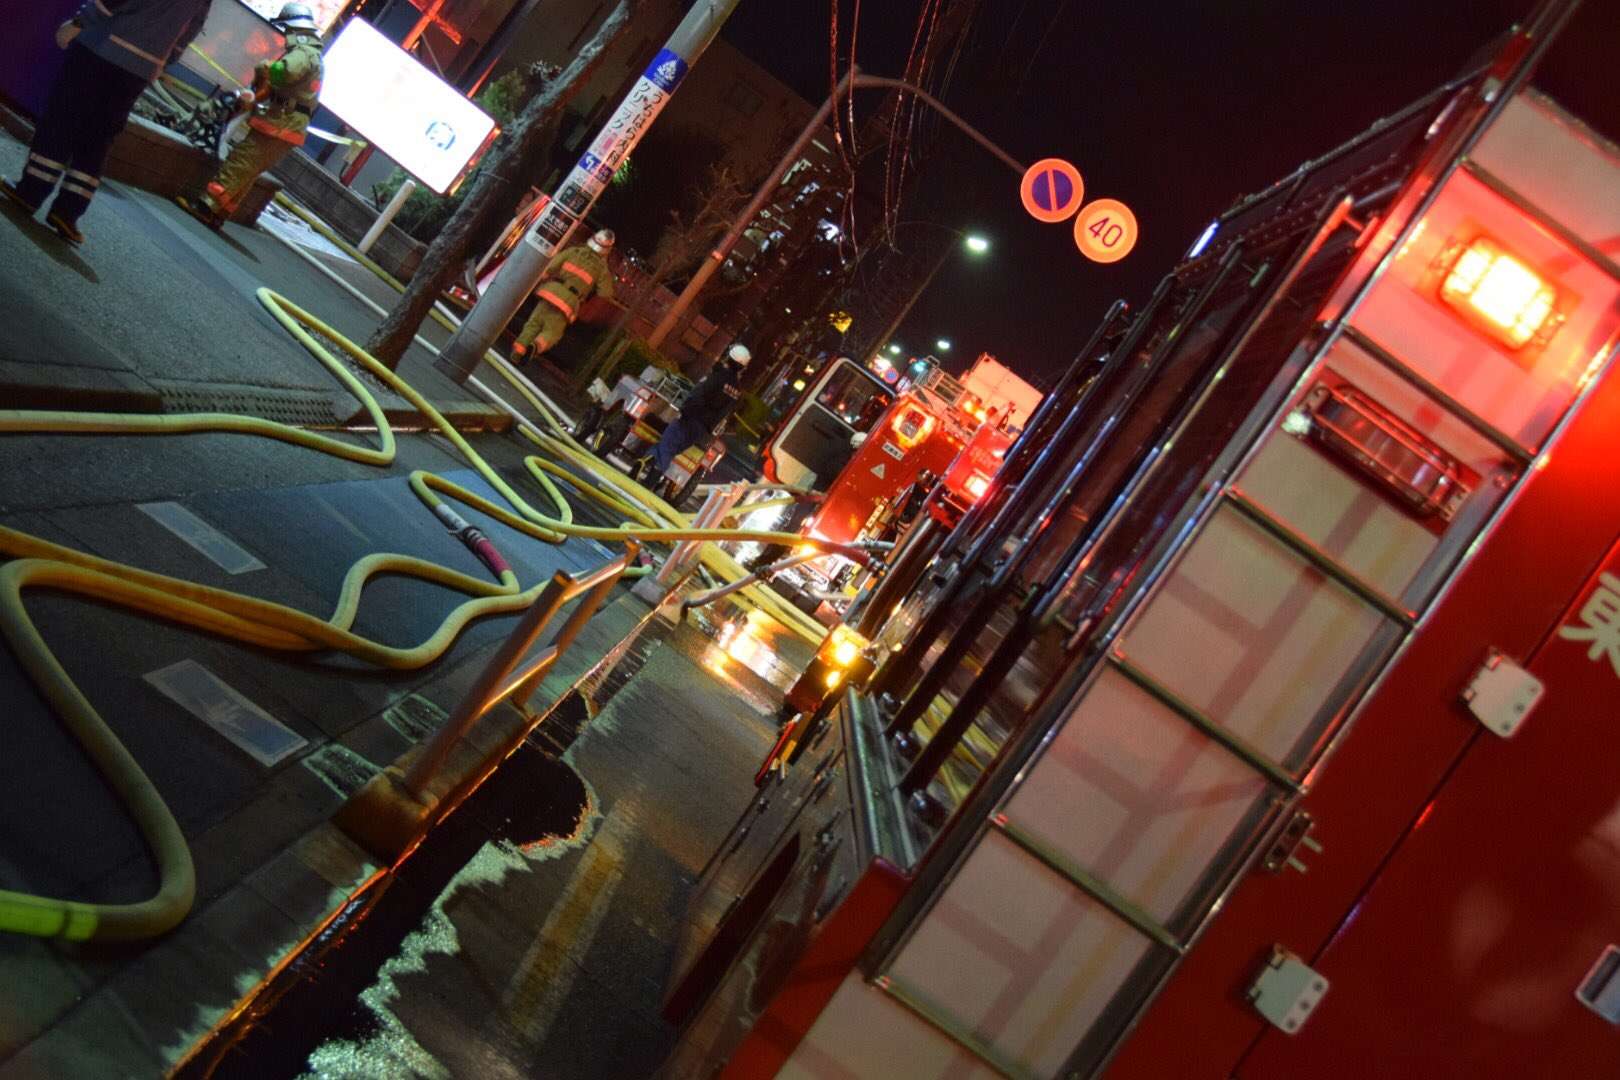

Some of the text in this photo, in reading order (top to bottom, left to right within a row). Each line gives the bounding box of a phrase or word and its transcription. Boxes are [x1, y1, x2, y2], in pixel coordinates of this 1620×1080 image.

[611, 81, 651, 130] クリニック
[1088, 216, 1123, 248] 40
